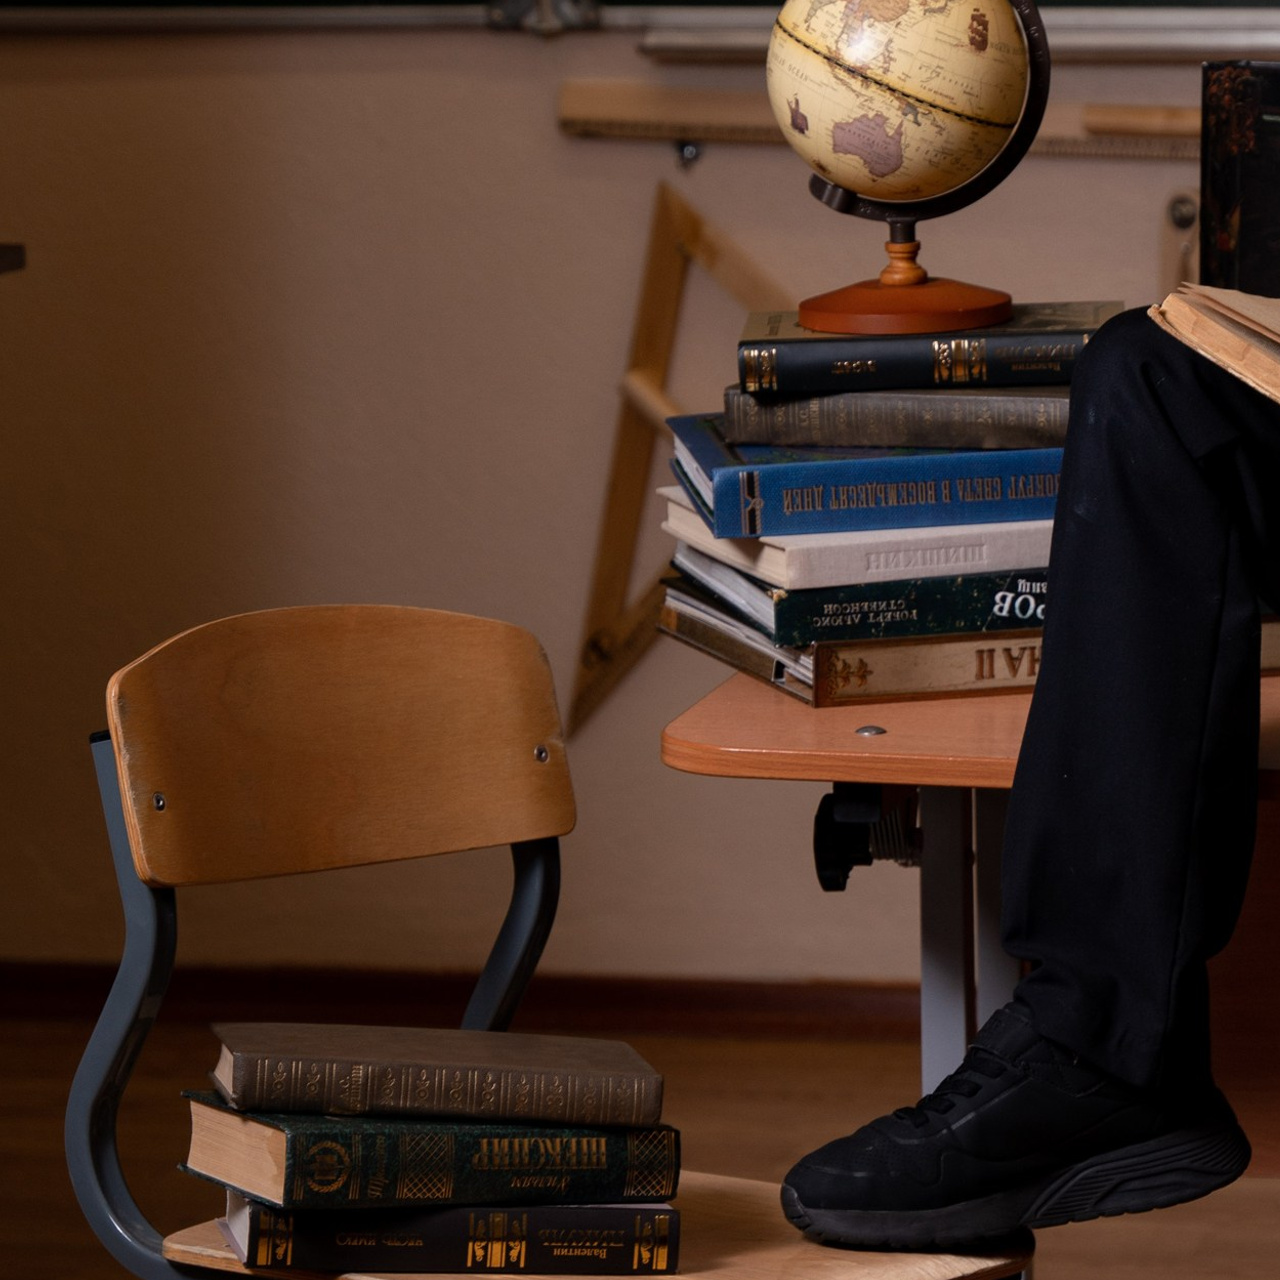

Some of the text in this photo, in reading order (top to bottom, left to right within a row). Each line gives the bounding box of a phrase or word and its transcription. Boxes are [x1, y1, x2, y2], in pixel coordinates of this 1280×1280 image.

[782, 487, 824, 515] ДНЕЙ
[829, 481, 937, 511] ВОСЕМЬДЕСЯТ
[942, 481, 953, 503] В
[956, 476, 1001, 502] СВЕТА
[471, 1136, 608, 1171] ШЕКСПИР
